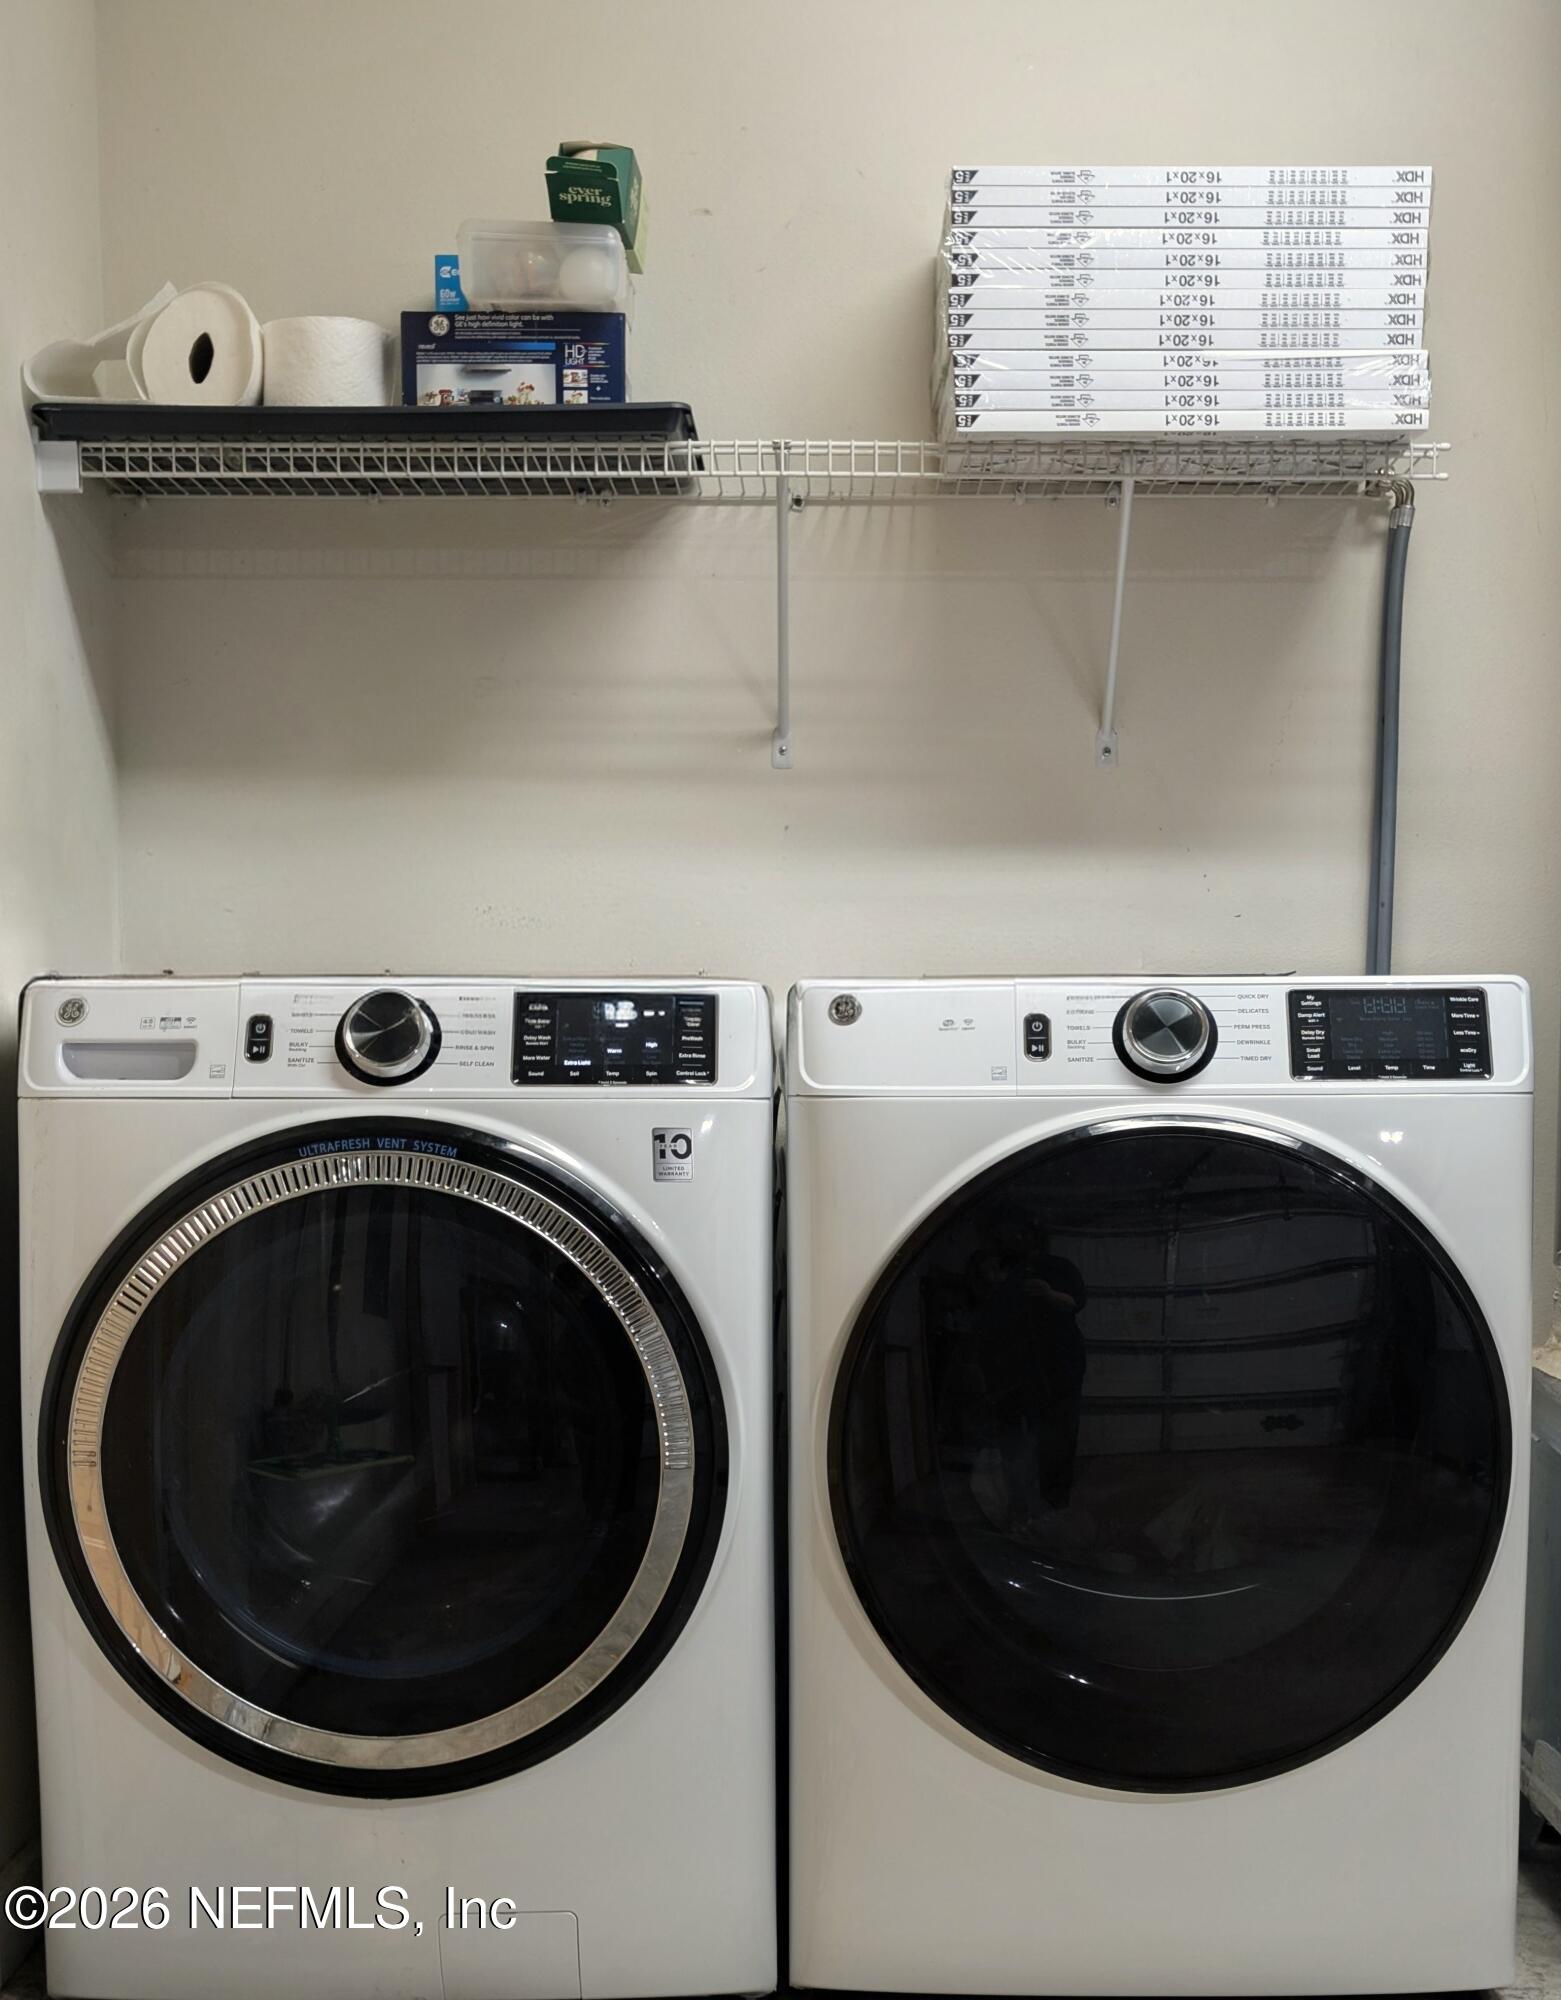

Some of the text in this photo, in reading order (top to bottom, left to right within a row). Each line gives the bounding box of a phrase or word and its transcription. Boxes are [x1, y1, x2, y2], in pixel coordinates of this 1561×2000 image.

[1396, 171, 1424, 183] HDX
[568, 186, 603, 196] ever
[559, 192, 612, 207] spring
[1394, 192, 1423, 203] HDX
[1393, 212, 1421, 224] HDX
[1391, 233, 1419, 244] HDX
[1395, 254, 1422, 266] HDX
[1393, 274, 1421, 286] HDX
[1388, 294, 1415, 305] HDX
[1388, 314, 1415, 325] HDX
[1387, 334, 1414, 345] HDX
[1393, 375, 1420, 386] HDX
[1395, 413, 1422, 424] HDX
[298, 1137, 458, 1158] ULTRAFRESH VENT SYSTEM
[654, 1134, 692, 1159] 10
